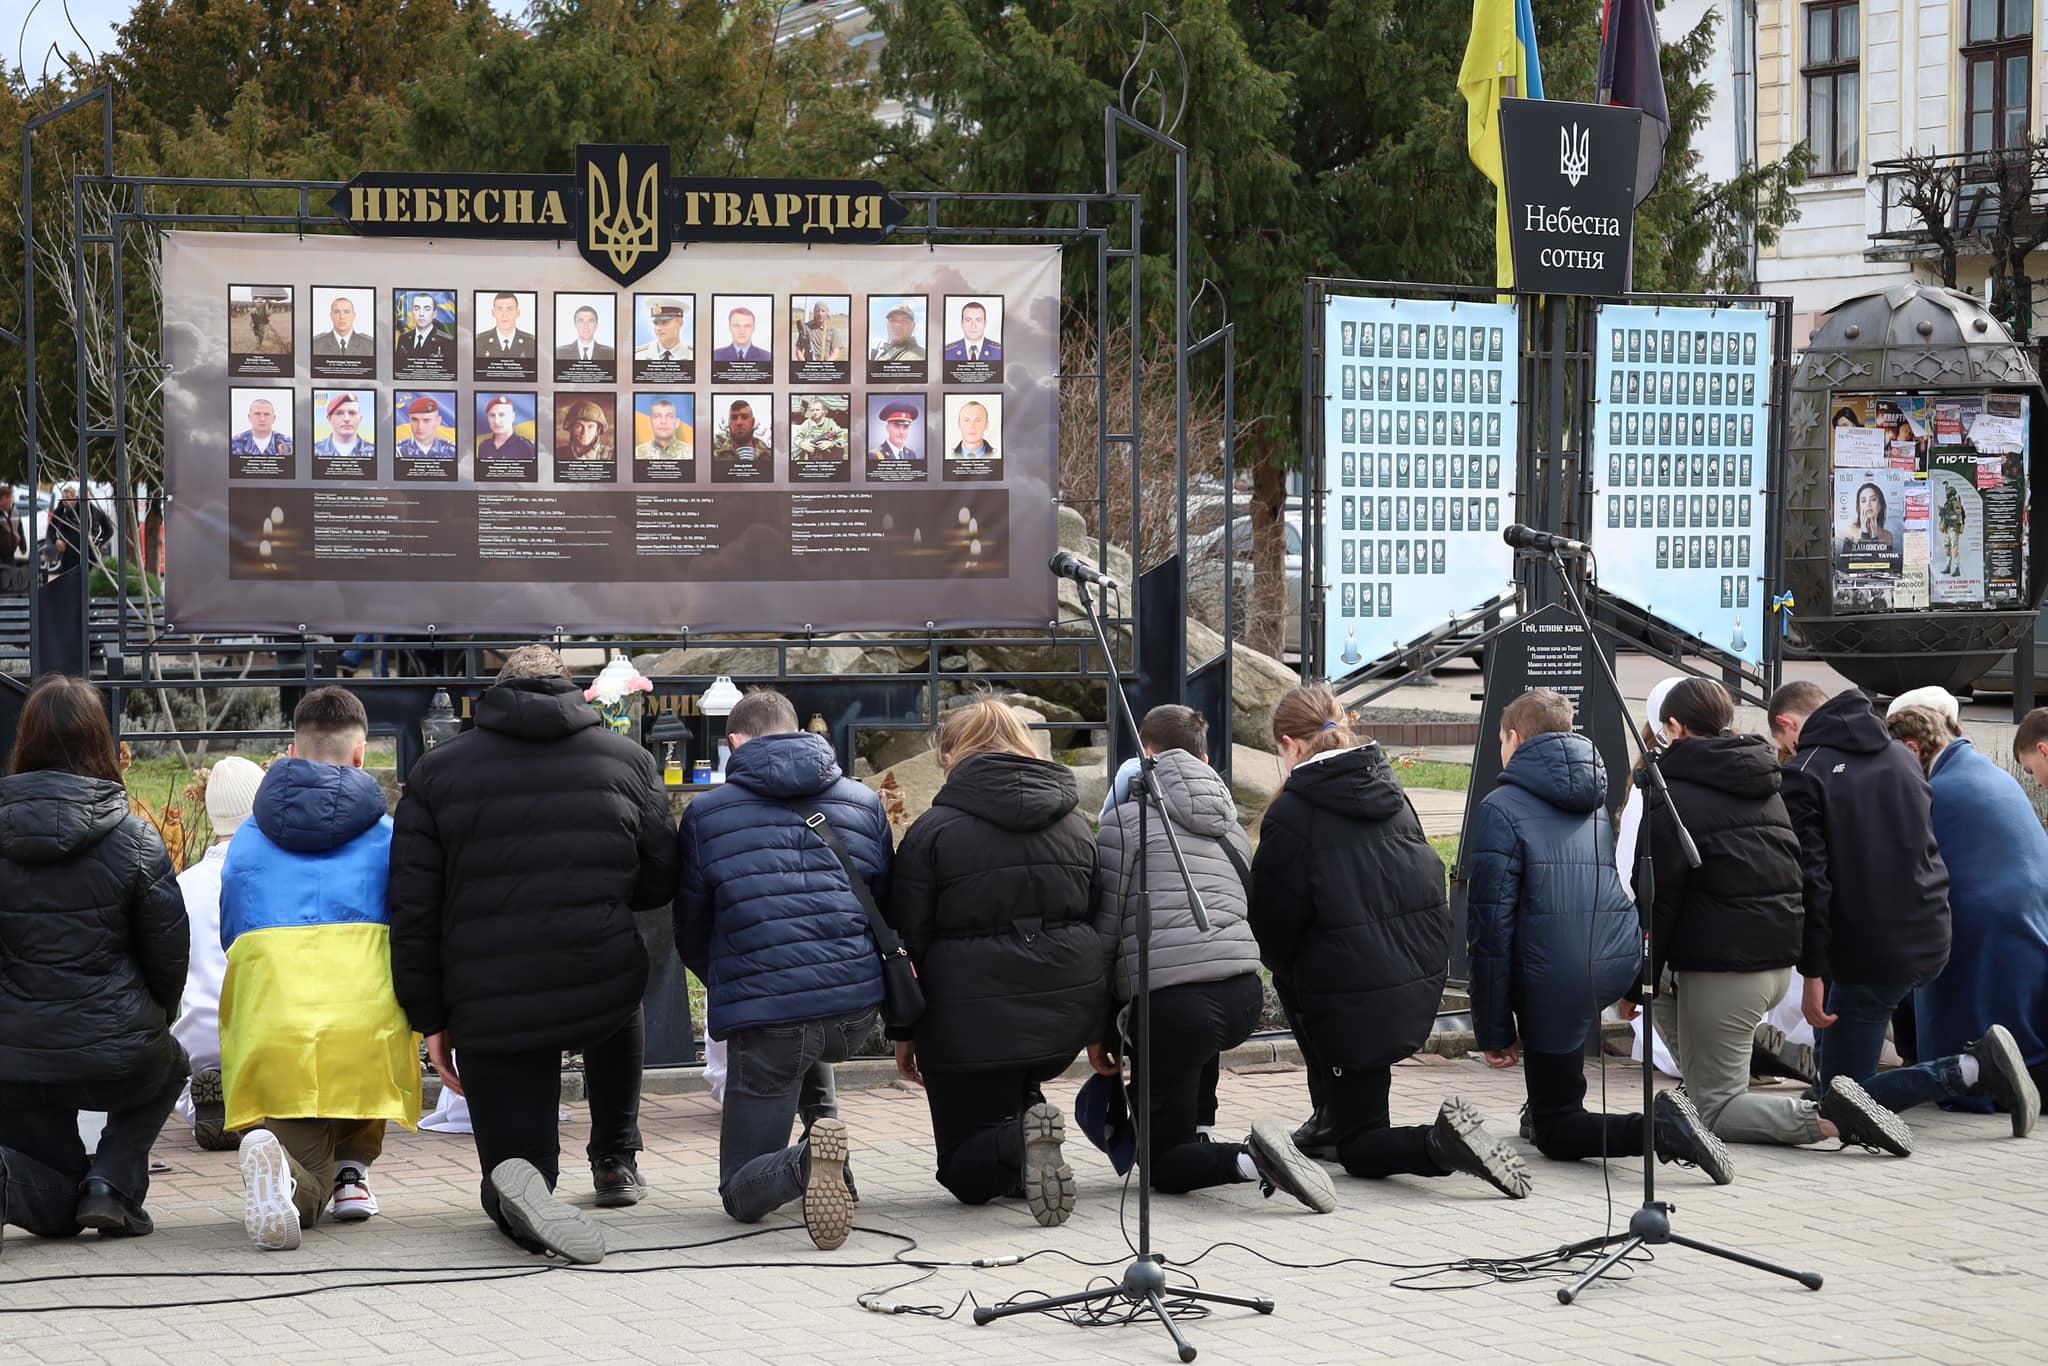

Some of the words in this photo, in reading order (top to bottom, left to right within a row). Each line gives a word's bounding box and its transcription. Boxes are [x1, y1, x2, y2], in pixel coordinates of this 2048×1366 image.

[349, 187, 567, 224] НЕБЕСНА
[685, 192, 883, 234] ГВАРДІЯ
[1524, 204, 1620, 236] Небесна
[1540, 248, 1605, 270] сотня
[1936, 455, 1978, 465] ЛЮТЬ
